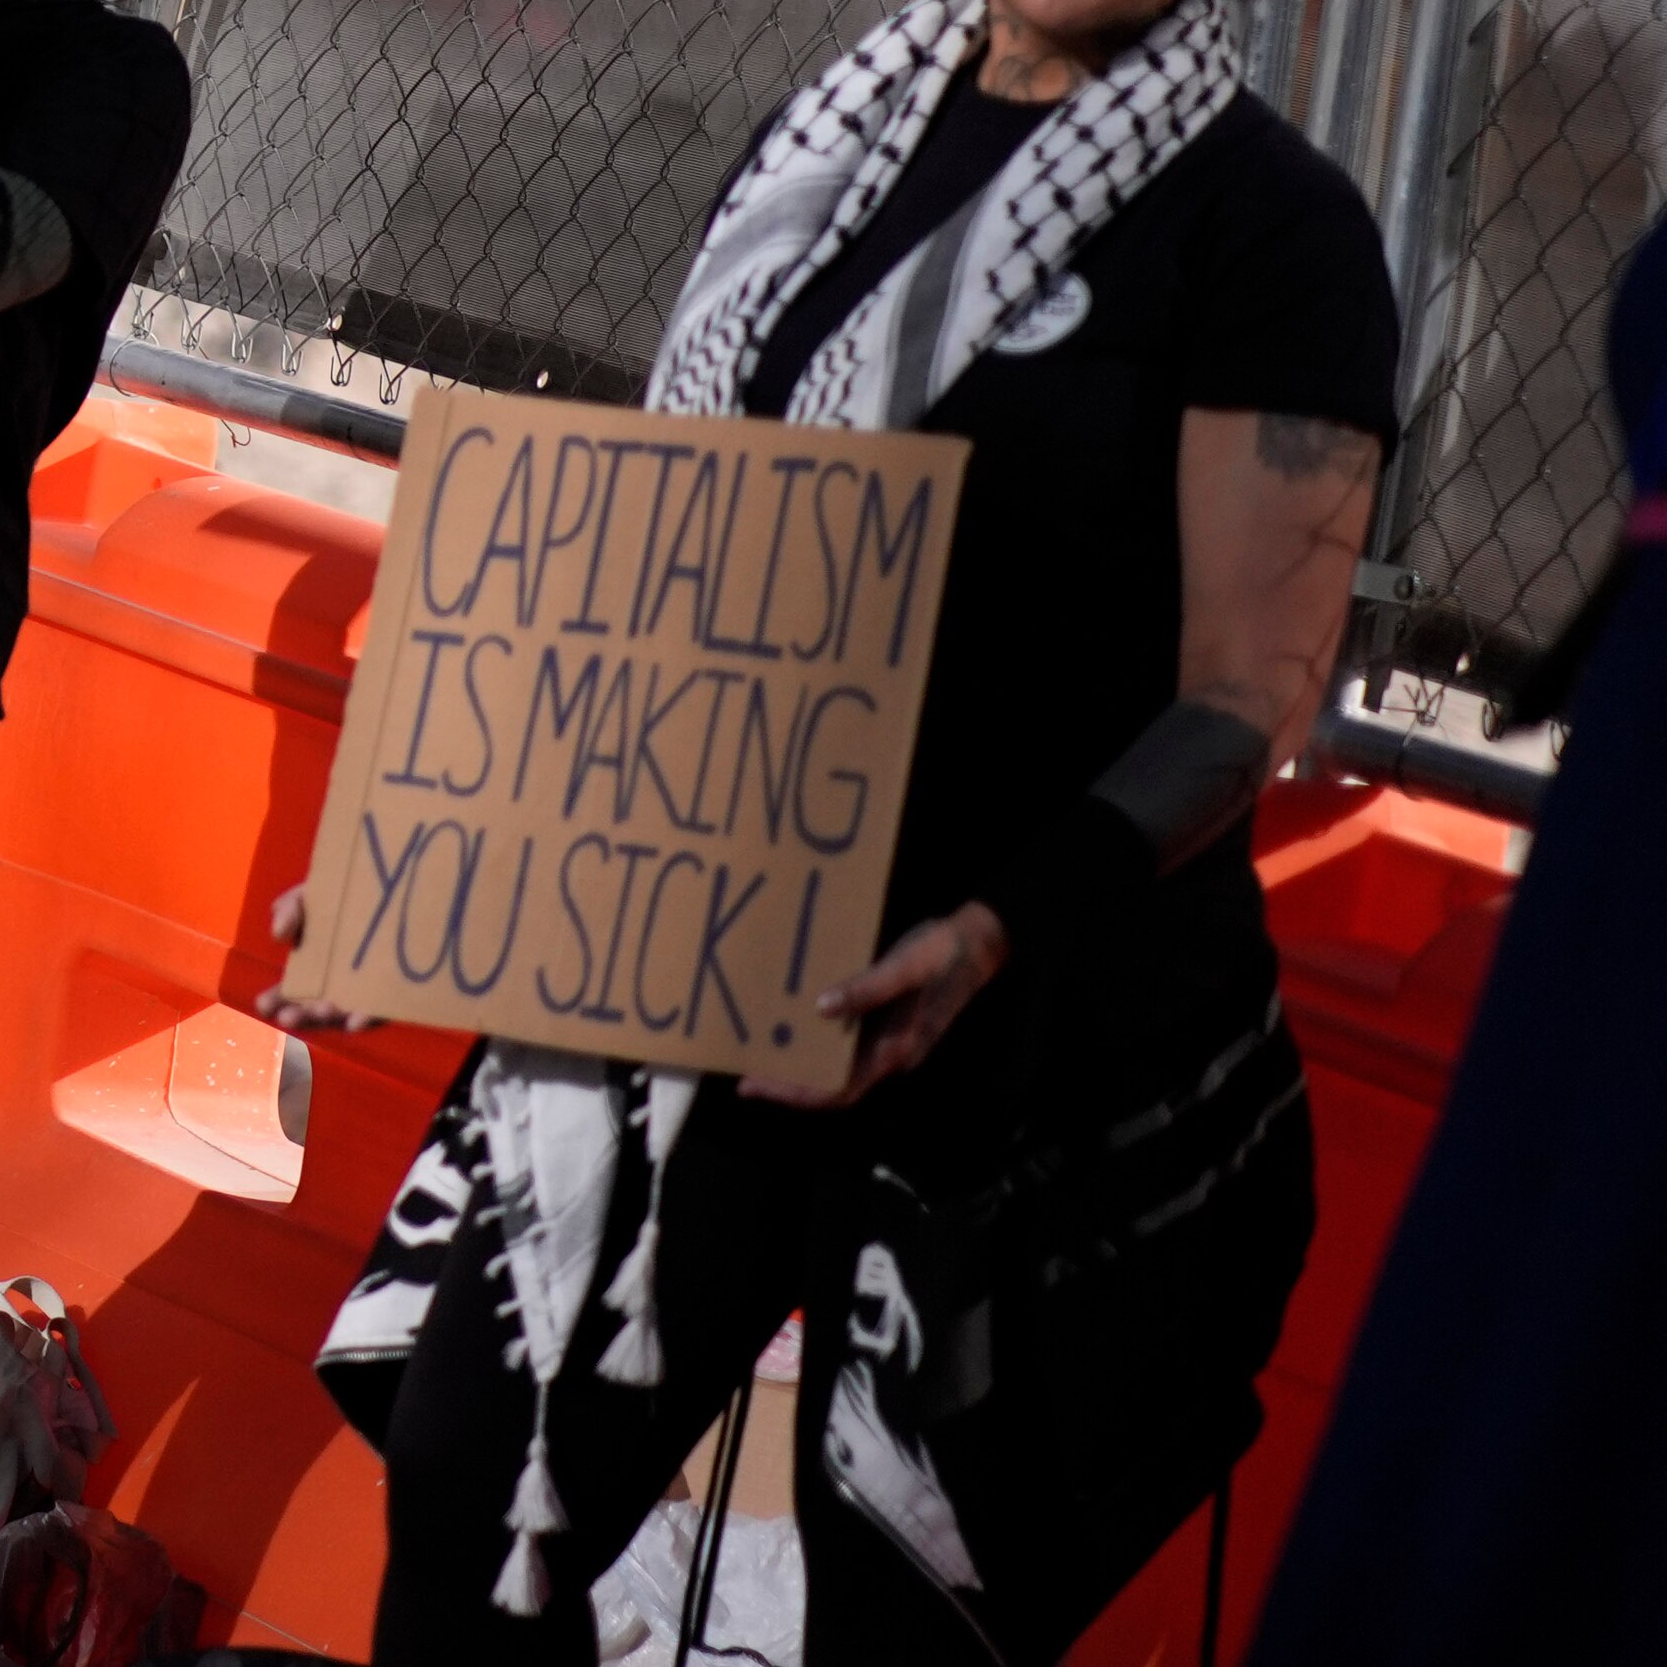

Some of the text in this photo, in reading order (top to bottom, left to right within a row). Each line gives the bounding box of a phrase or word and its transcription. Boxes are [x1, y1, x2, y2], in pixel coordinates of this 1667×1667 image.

[422, 427, 934, 670] CAPITALISM
[382, 629, 879, 856] IS MAKING
[351, 811, 822, 1050] YOU SICK!
